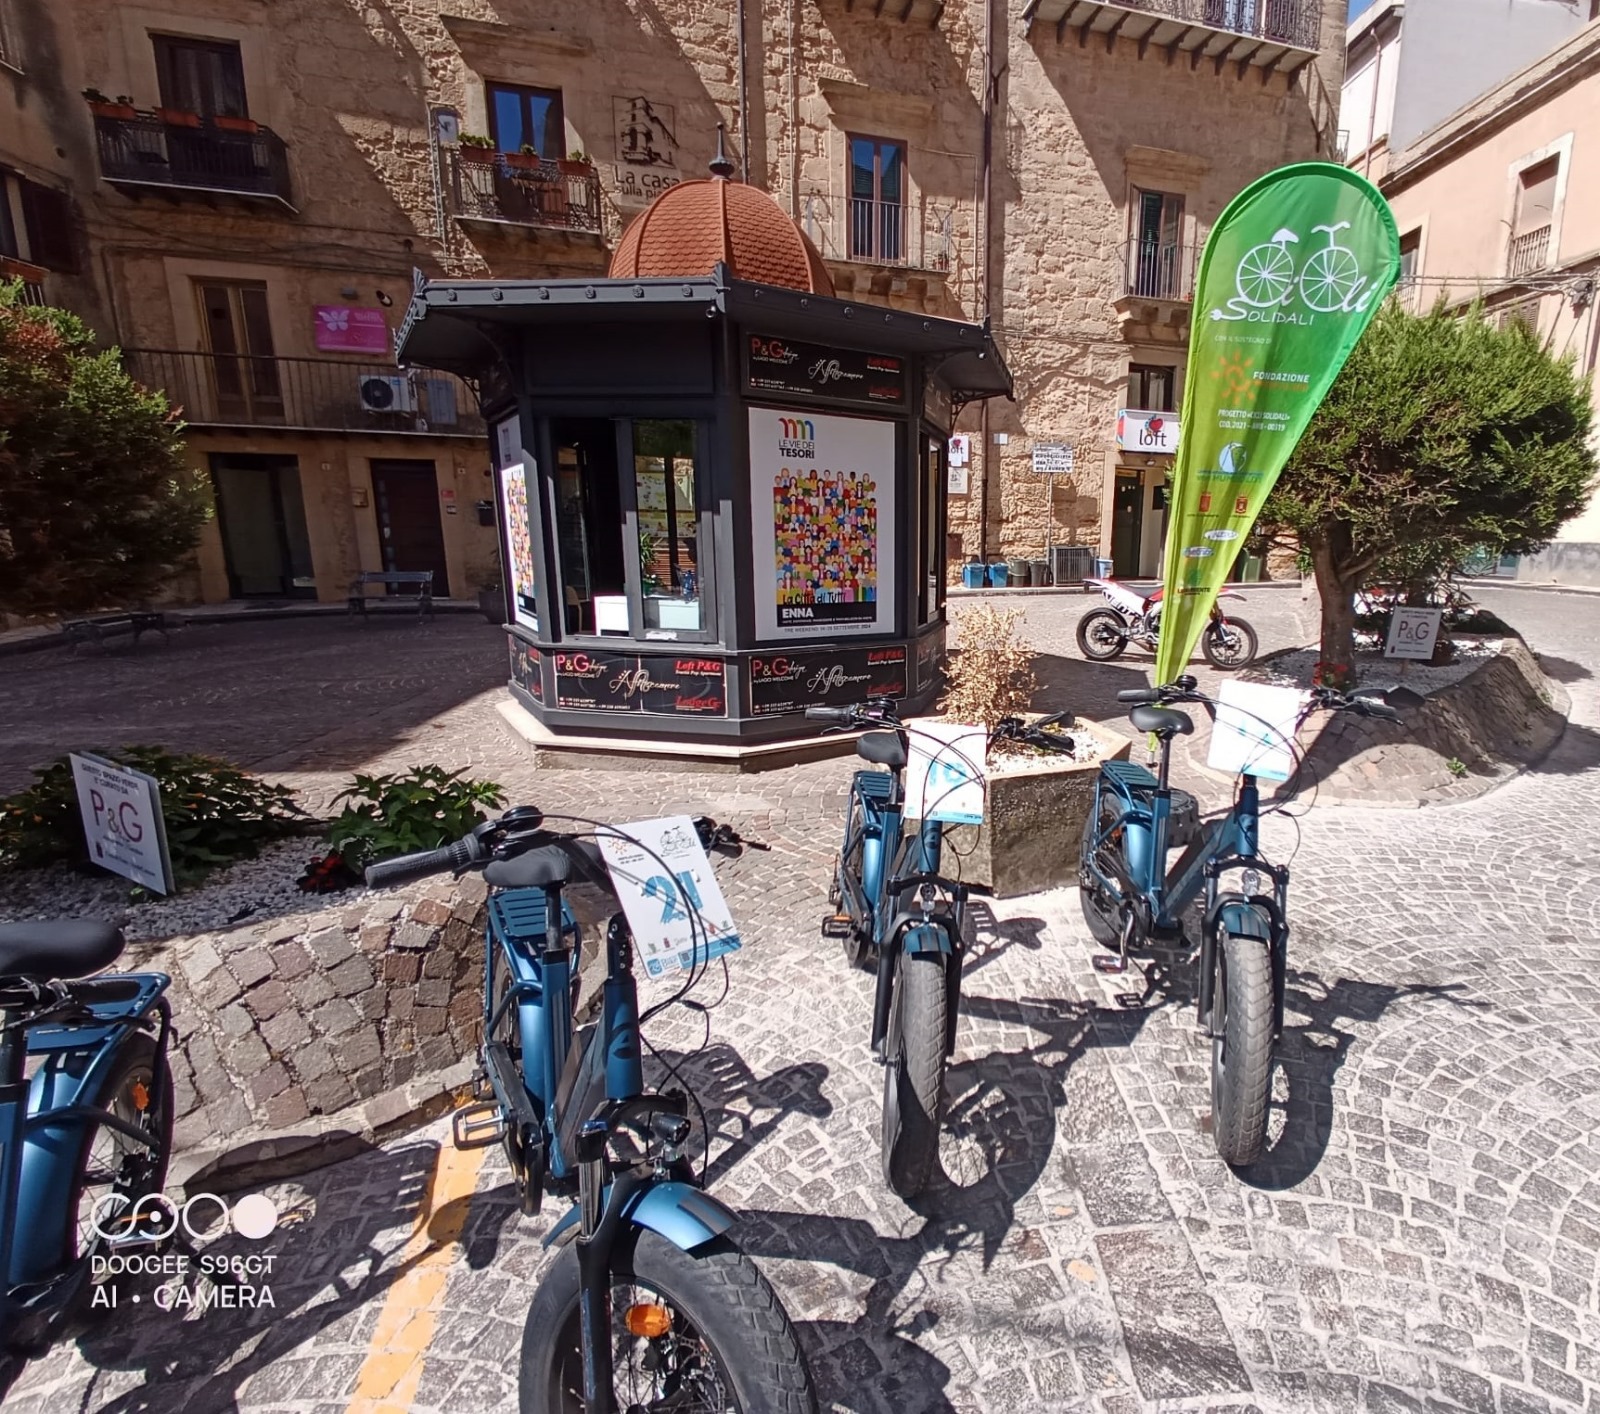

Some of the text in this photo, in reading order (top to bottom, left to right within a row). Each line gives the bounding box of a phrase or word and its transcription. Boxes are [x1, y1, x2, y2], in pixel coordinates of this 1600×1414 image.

[615, 165, 635, 185] La
[1253, 371, 1310, 383] FONDAZIONE
[1217, 409, 1247, 419] PROGETTO
[779, 438, 815, 450] LE VIE DEI
[1139, 430, 1168, 447] loft
[779, 447, 815, 459] TESORI
[782, 607, 814, 619] ENNA
[1398, 620, 1430, 640] P&G
[556, 654, 589, 672] P&G
[676, 660, 694, 671] Loft
[752, 658, 789, 677] P&G
[90, 788, 143, 843] P&G
